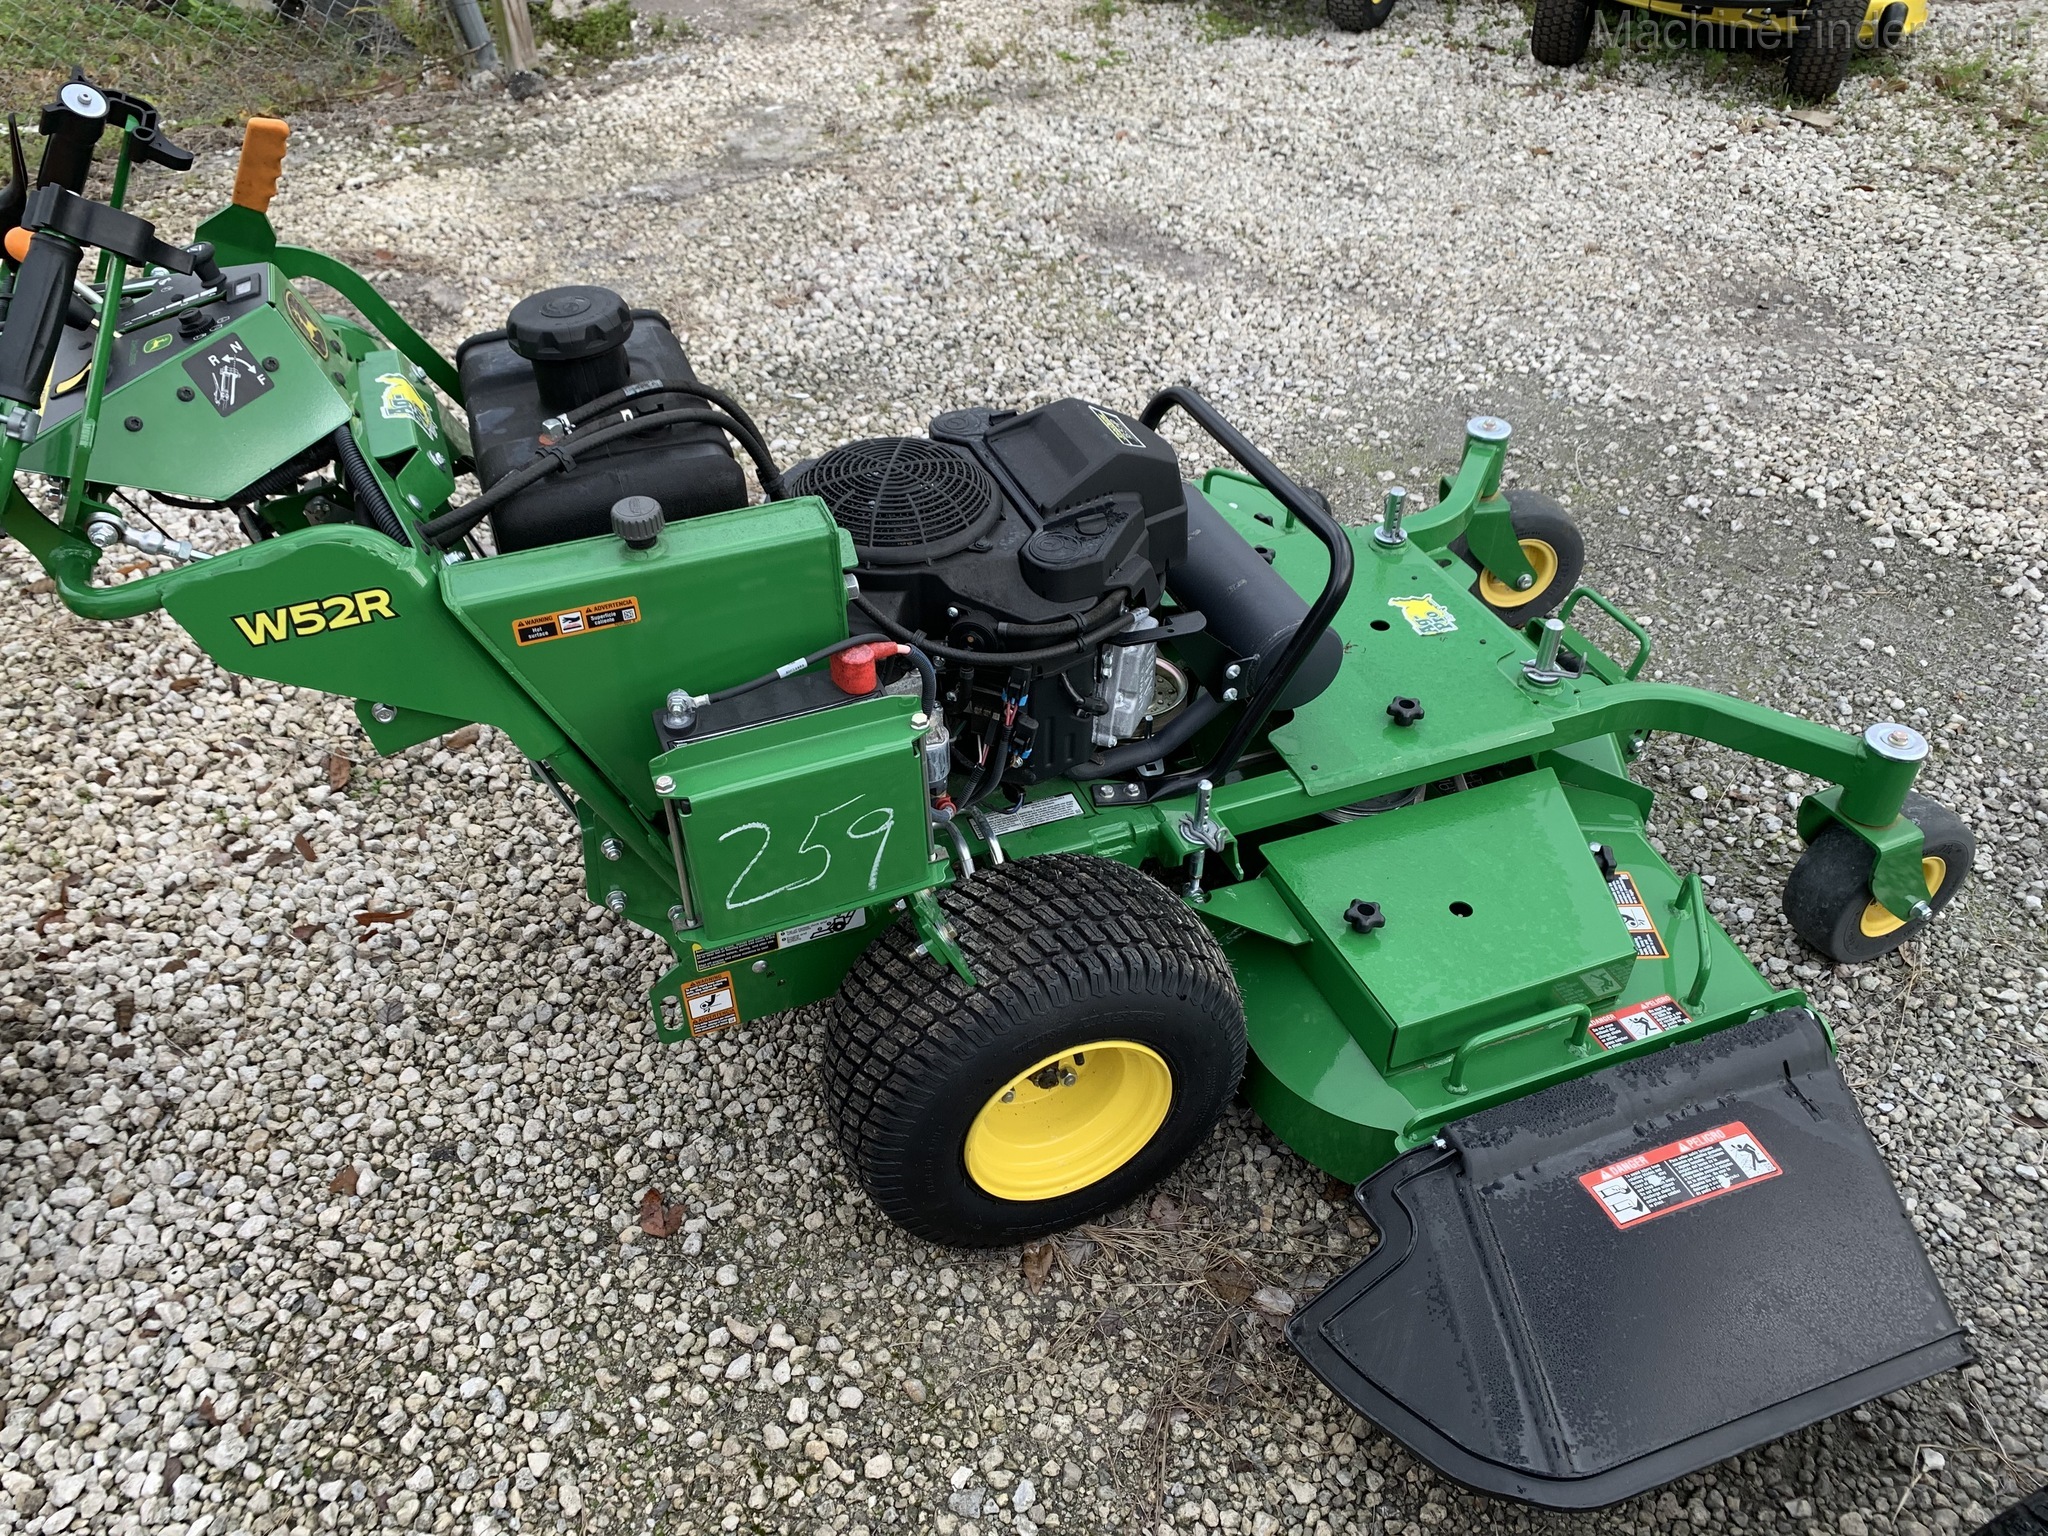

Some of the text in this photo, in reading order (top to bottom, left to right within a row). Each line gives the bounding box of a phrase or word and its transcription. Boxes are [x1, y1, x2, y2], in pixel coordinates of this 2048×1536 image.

[229, 340, 243, 353] N
[207, 354, 221, 367] R
[256, 374, 267, 386] F
[594, 599, 633, 612] ADVERTENCIA
[232, 588, 400, 648] W52R
[525, 615, 553, 626] WARNING
[717, 793, 895, 910] 259
[1646, 995, 1671, 1007] PELIGRO
[1592, 1013, 1617, 1026] DANGER
[1687, 1129, 1727, 1149] PELIGRO
[1609, 1156, 1650, 1176] DANGER
